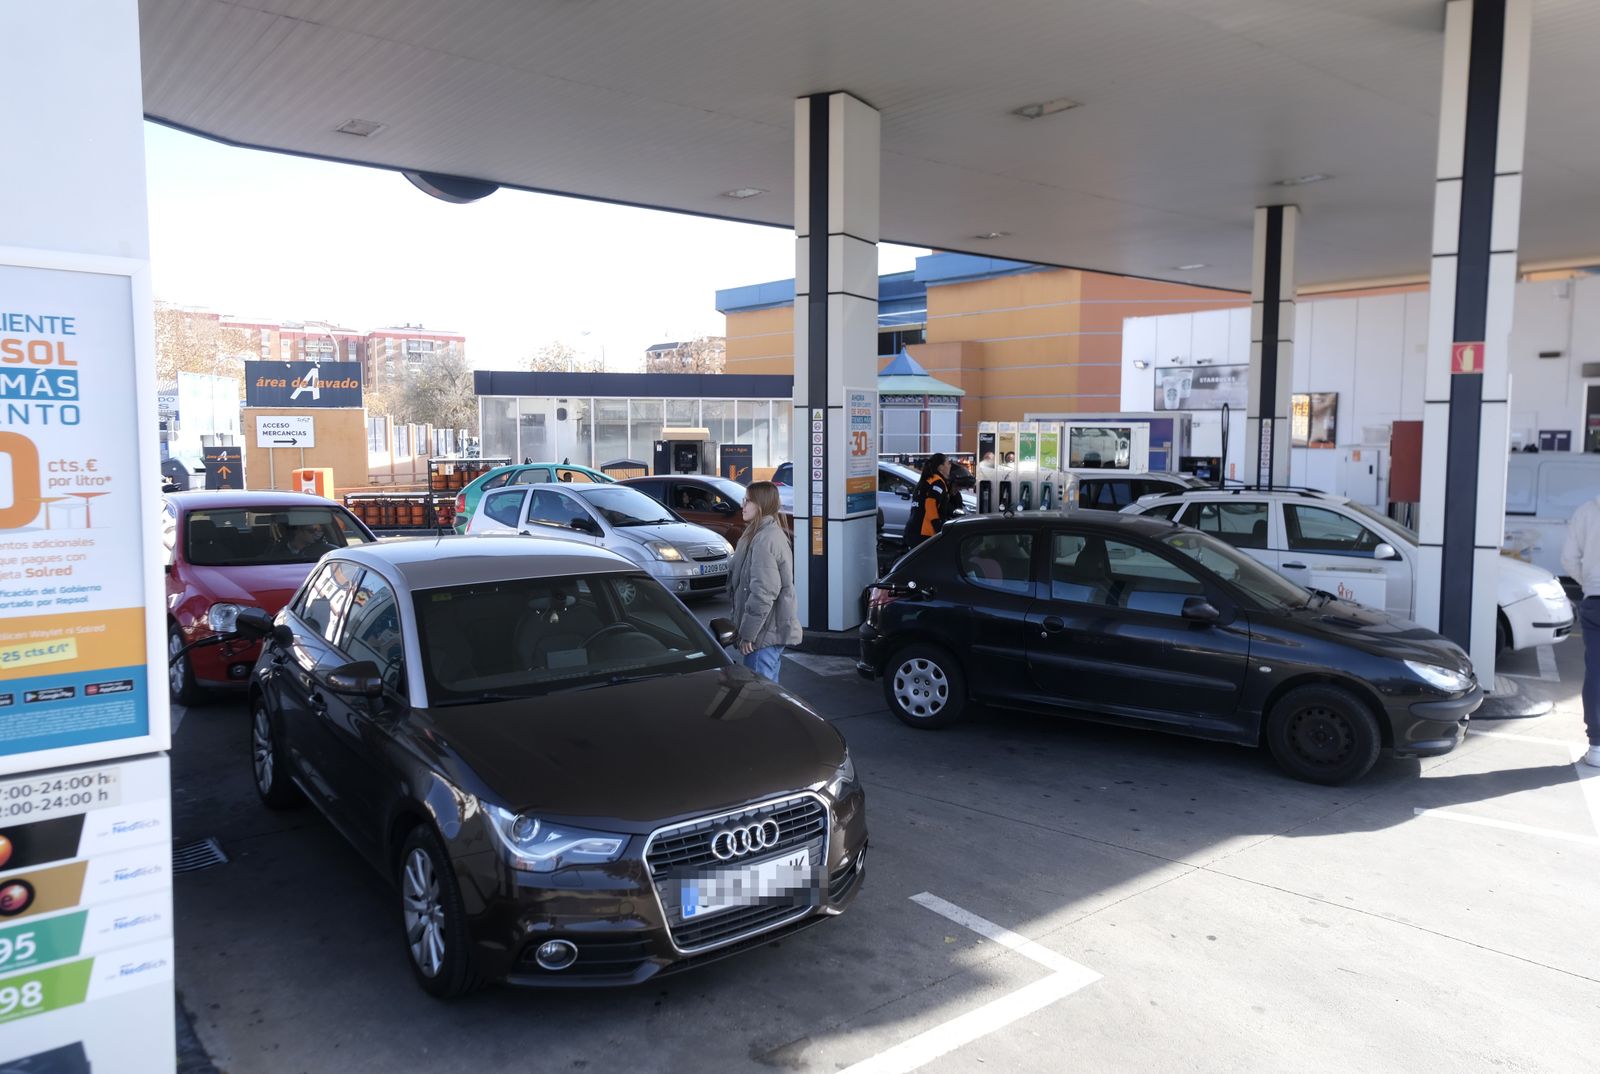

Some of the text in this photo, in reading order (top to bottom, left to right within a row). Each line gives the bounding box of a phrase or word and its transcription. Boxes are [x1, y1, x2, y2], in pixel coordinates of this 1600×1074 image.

[0, 313, 76, 335] IENTE
[0, 369, 77, 398] MÁS
[256, 376, 286, 387] área
[0, 403, 80, 426] NTO
[48, 458, 99, 473] cts.€
[49, 477, 72, 489] por
[21, 555, 63, 565] pagues
[66, 553, 87, 562] con
[25, 565, 73, 578] Solred
[0, 775, 92, 800] :00-24:00
[0, 788, 109, 818] :00-24:00 h
[0, 980, 44, 1016] 98
